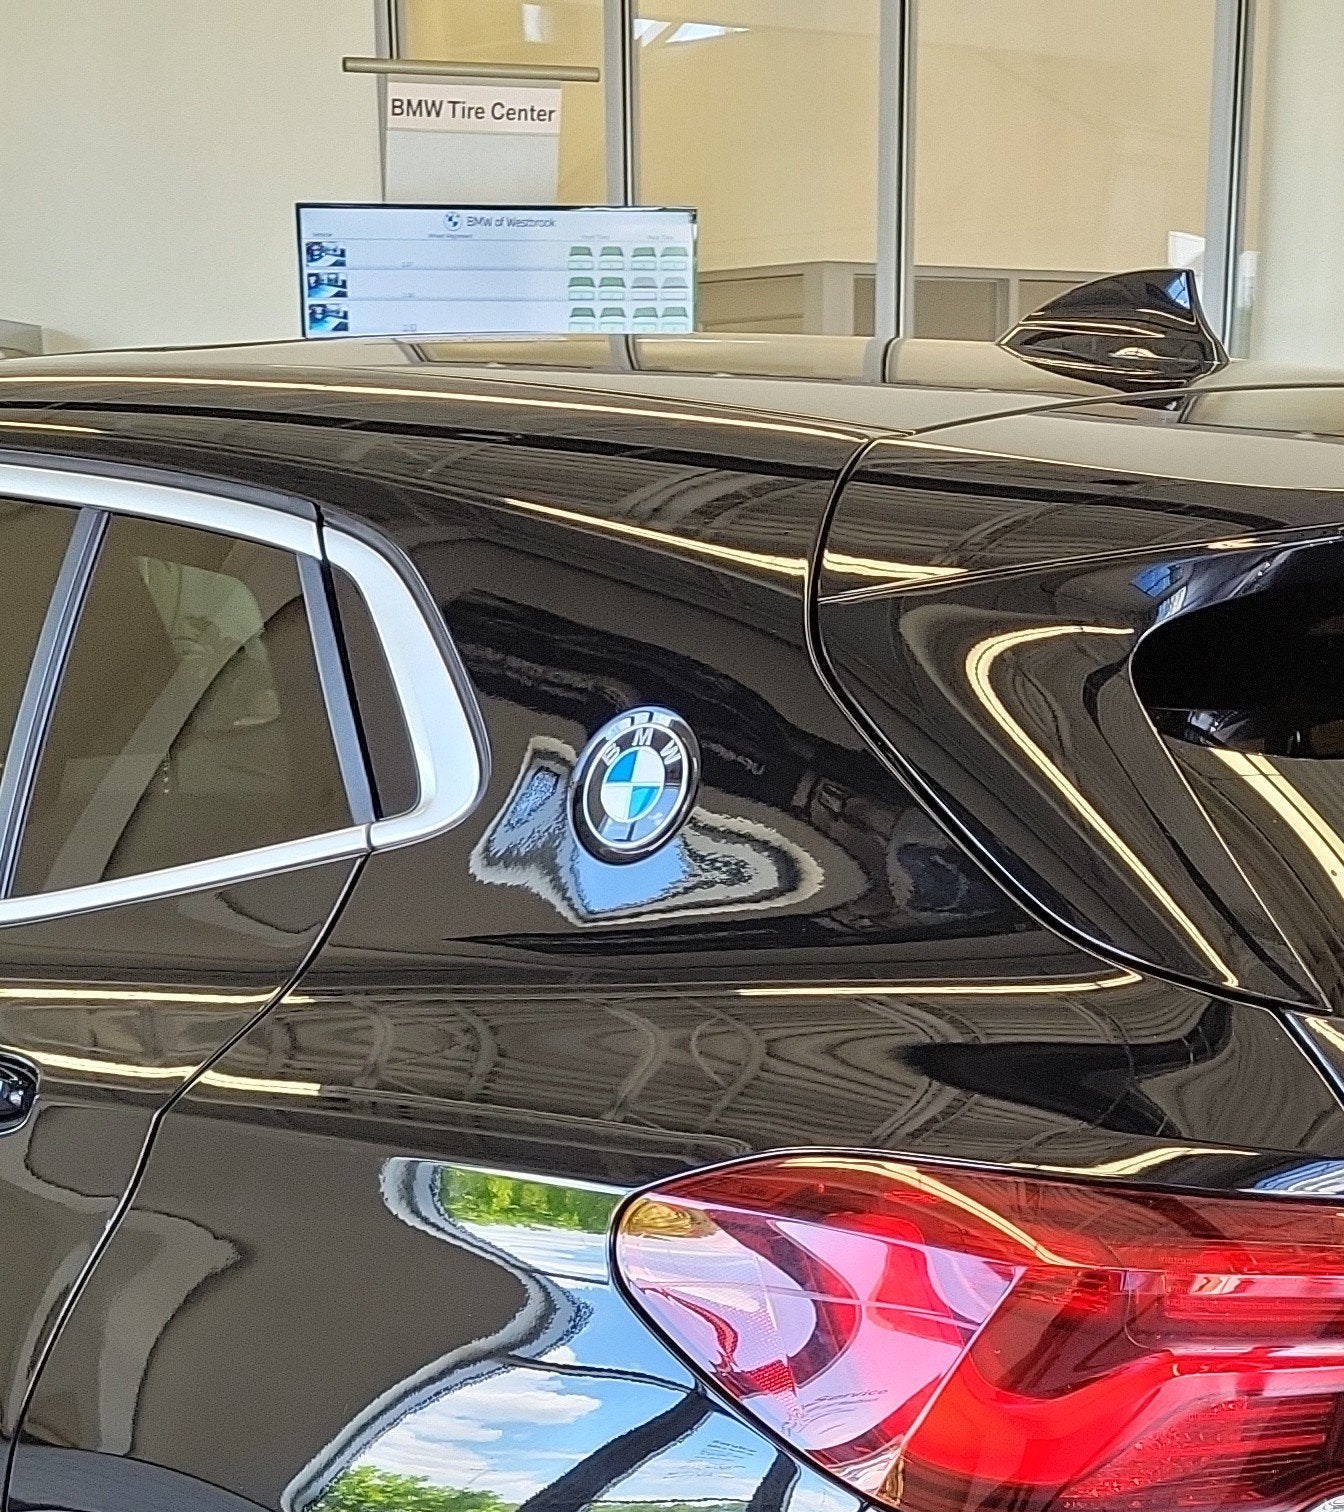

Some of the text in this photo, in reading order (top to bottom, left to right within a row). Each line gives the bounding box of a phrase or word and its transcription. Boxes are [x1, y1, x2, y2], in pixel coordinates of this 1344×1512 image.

[391, 98, 556, 122] BMW Tire Center
[467, 216, 492, 227] BMW
[602, 727, 682, 766] BMW
